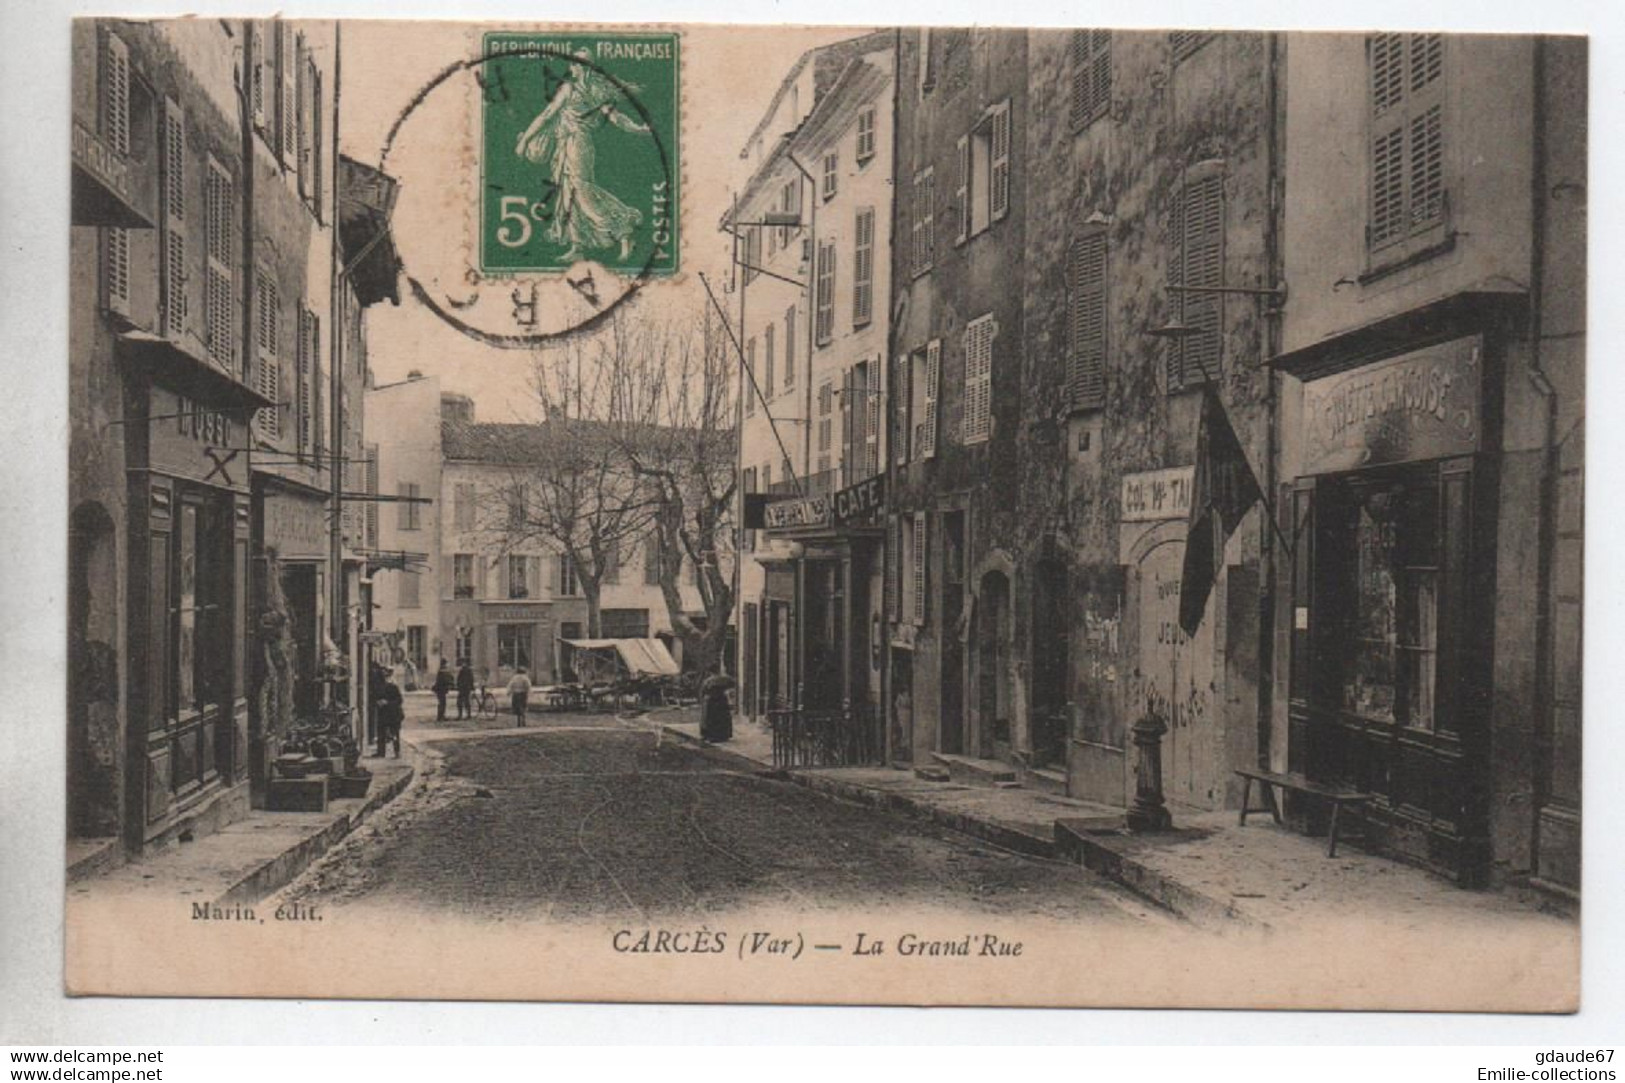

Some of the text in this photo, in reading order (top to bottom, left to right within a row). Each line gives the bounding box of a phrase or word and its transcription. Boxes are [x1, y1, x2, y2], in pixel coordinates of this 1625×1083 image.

[596, 41, 673, 62] FRANÇAISE
[652, 180, 671, 260] POSTES
[191, 901, 323, 926] Marin, édit.
[612, 926, 728, 954] CARCÈS
[738, 932, 804, 961] (Var)
[852, 932, 884, 956] La
[896, 933, 1024, 957] Grand'Rue
